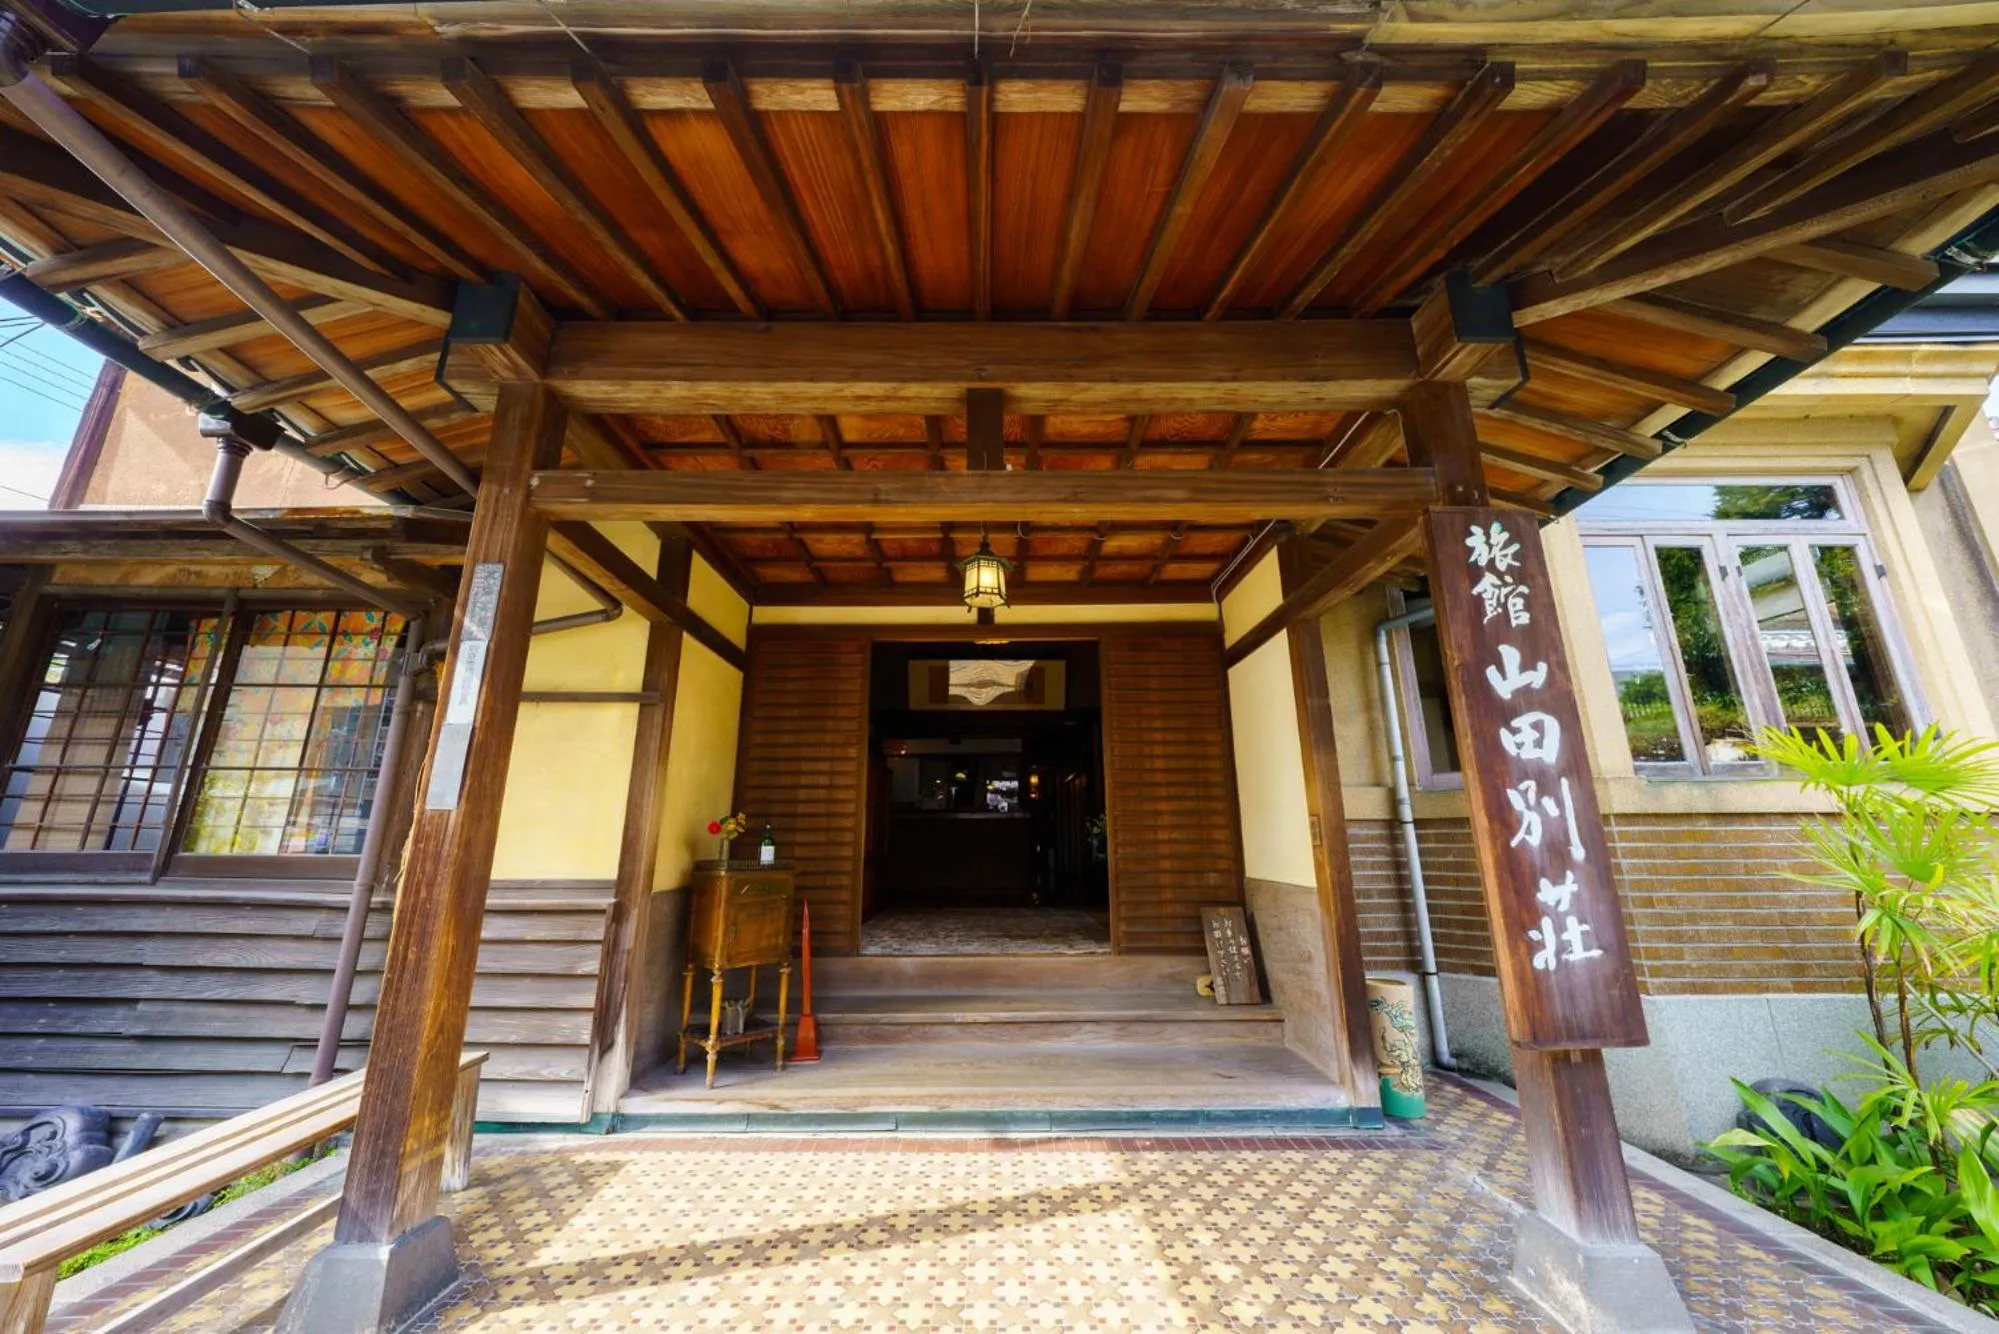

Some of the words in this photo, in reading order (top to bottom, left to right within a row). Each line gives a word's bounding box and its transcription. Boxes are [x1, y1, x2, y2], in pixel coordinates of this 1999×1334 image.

[1465, 522, 1531, 628] 旅館
[1485, 643, 1604, 975] 山田別荘
